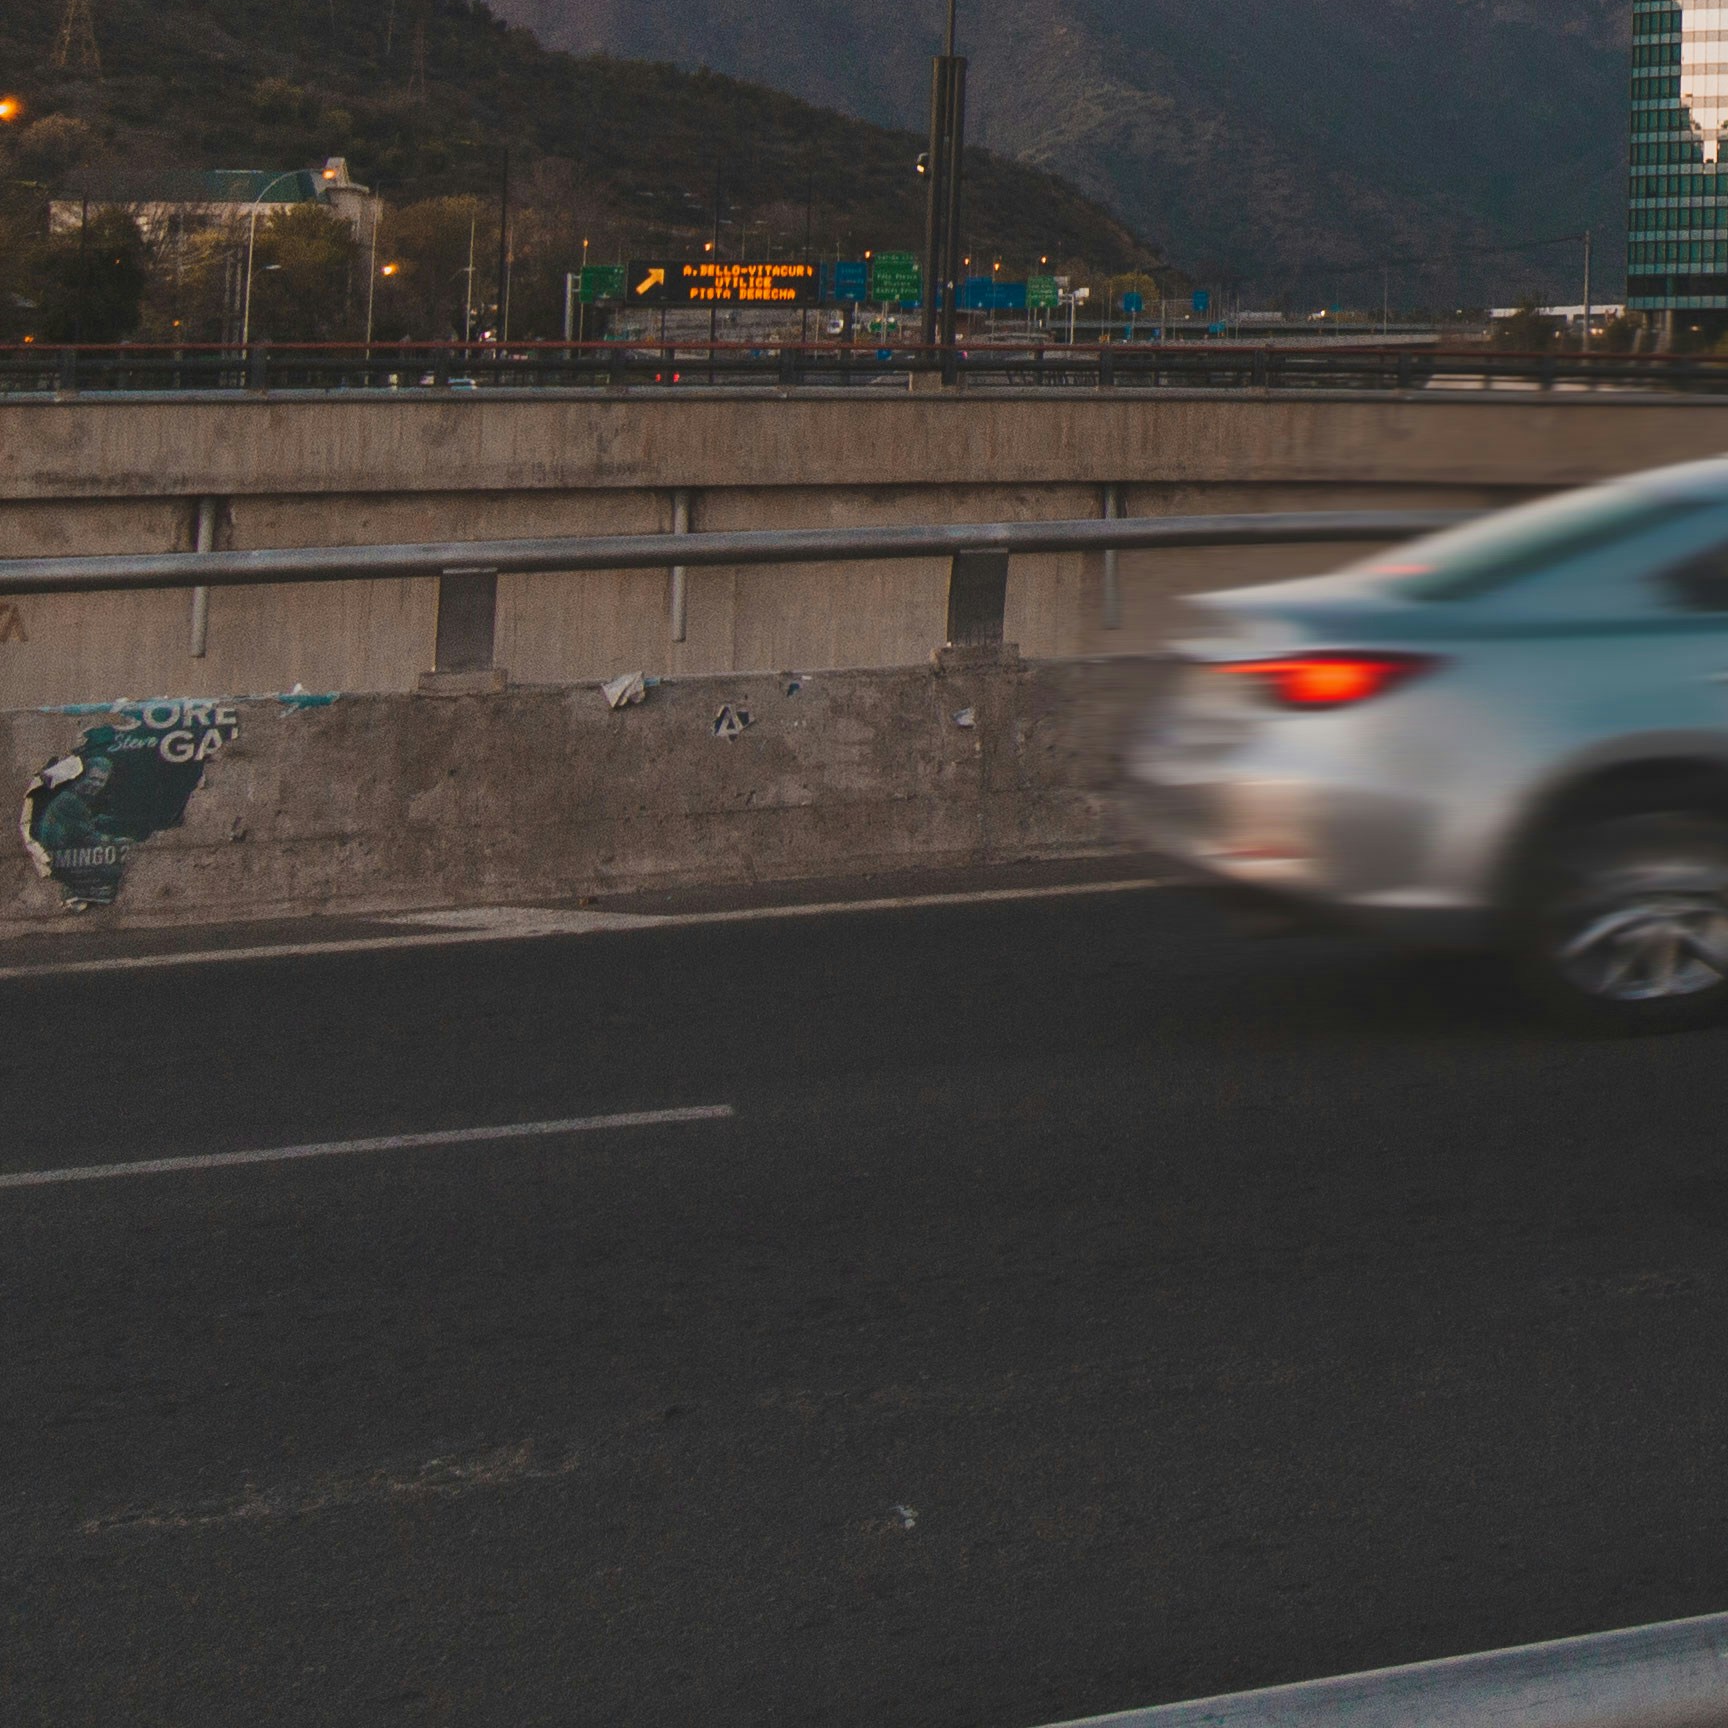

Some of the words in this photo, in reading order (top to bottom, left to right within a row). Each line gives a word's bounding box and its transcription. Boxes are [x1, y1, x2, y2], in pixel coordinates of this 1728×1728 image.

[715, 276, 772, 288] UTILICE
[690, 287, 731, 300] PISTA
[739, 287, 796, 300] DERECHA
[107, 733, 157, 752] Steve
[160, 728, 239, 763] GA
